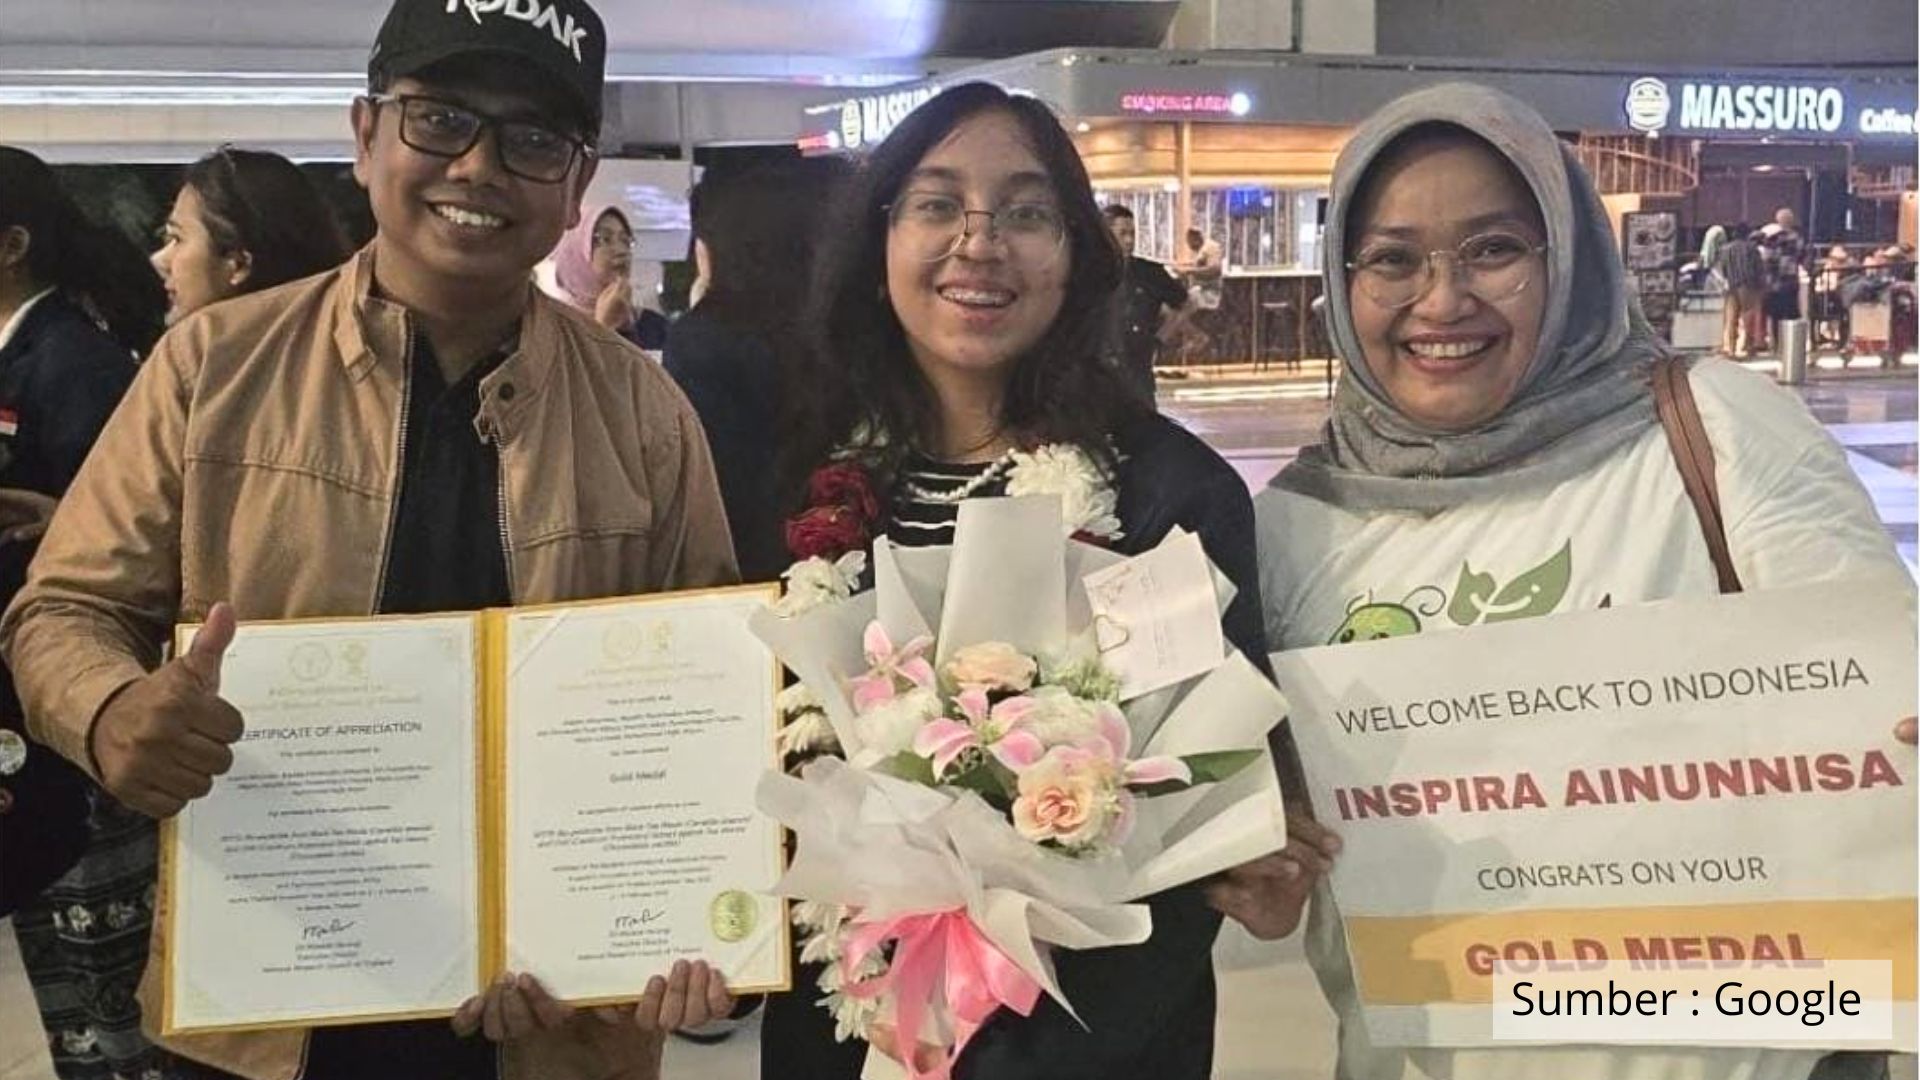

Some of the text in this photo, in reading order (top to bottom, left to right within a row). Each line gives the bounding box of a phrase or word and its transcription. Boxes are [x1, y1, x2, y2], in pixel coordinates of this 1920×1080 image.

[1680, 84, 1843, 132] MASSURO
[1336, 657, 1869, 735] WELCOME BACK TO INDONESIA
[1335, 749, 1902, 821] INSPIRA AINUNNISA
[1477, 856, 1768, 891] CONGRATS ON YOUR
[1465, 933, 1825, 977] GOLD MEDAL
